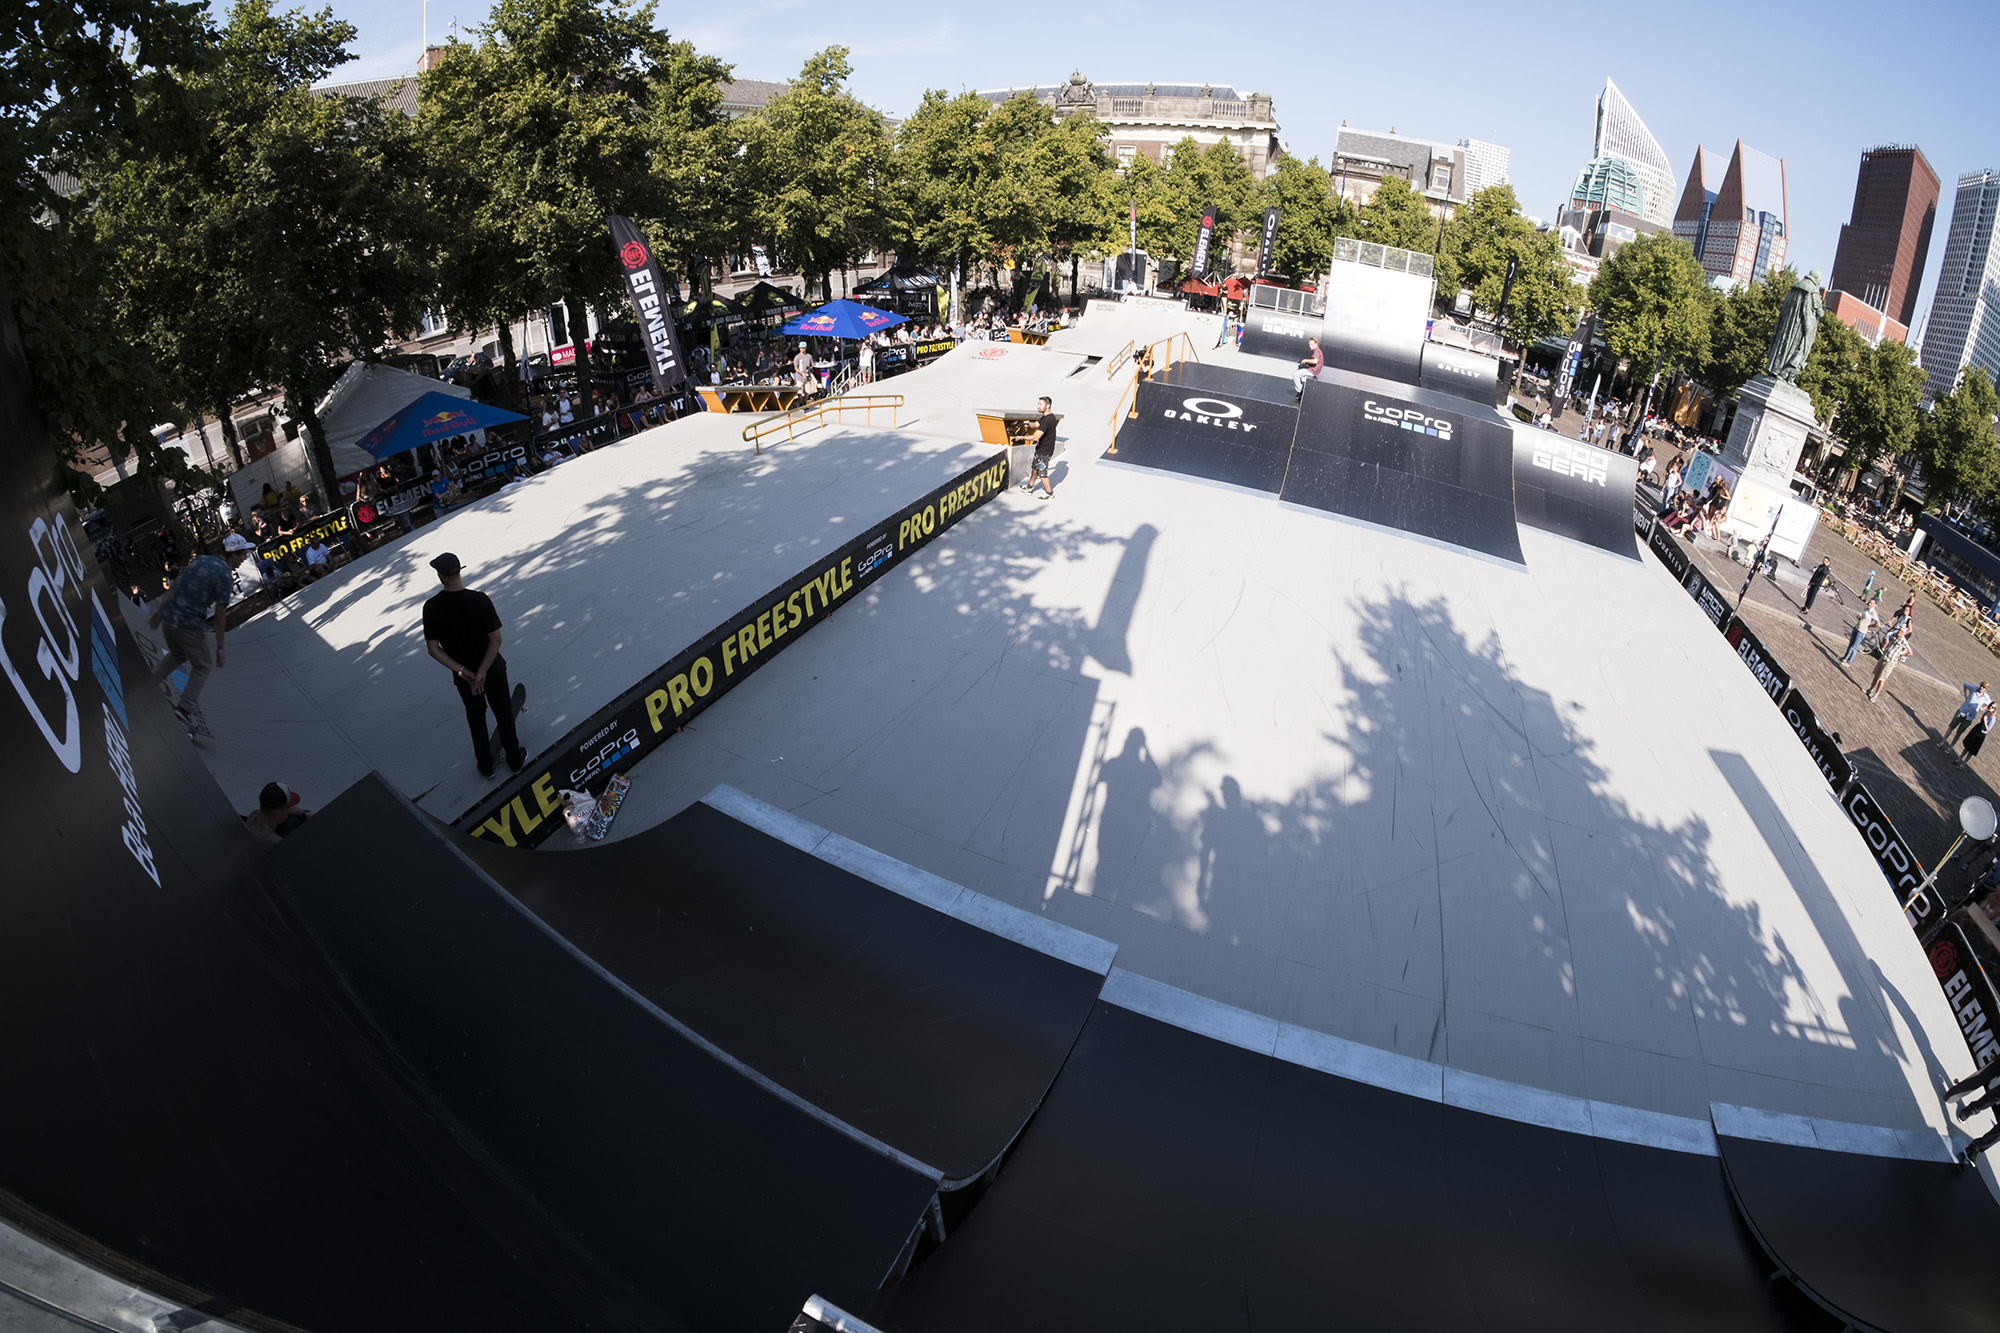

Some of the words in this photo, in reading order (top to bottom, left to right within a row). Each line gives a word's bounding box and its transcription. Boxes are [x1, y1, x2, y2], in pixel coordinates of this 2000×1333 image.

[1194, 227, 1210, 272] ELEMENT
[1136, 299, 1175, 309] GoPro
[799, 323, 816, 331] Red
[815, 324, 835, 332] Bull
[1262, 324, 1305, 338] GEAR
[1263, 315, 1306, 328] MADD
[881, 347, 907, 358] oPro
[917, 345, 929, 354] PRO
[627, 369, 651, 382] GoP
[1437, 363, 1480, 378] OAKLEY
[1555, 341, 1577, 398] GoPro
[421, 424, 450, 438] Red
[449, 416, 477, 431] Bull
[1164, 409, 1256, 432] OAKLEY
[1364, 401, 1453, 432] GoPro
[561, 424, 608, 445] OALEY
[462, 446, 526, 474] oPro
[1535, 434, 1609, 471] MADD
[1532, 450, 1607, 488] GEAR
[375, 481, 433, 516] ELEMEN
[899, 504, 935, 551] PRO
[939, 459, 1006, 525] FREESTYLE
[1633, 510, 1650, 535] MENT
[263, 544, 289, 562] PRO
[858, 543, 893, 572] GoPro
[1660, 542, 1683, 573] OAKLEY
[1701, 585, 1725, 618] MADD
[0, 512, 84, 774] GoPro
[645, 656, 714, 733] PRO
[721, 556, 853, 676] FREESTYLE
[1737, 637, 1783, 698] ELEMENT
[579, 726, 610, 753] POWERED
[609, 719, 618, 730] BY
[569, 728, 637, 783] GoPro
[1800, 726, 1837, 783] OAKLEY
[121, 819, 162, 888] Be
[1850, 793, 1931, 918] GoPro
[1943, 968, 2000, 1070] ELEME
